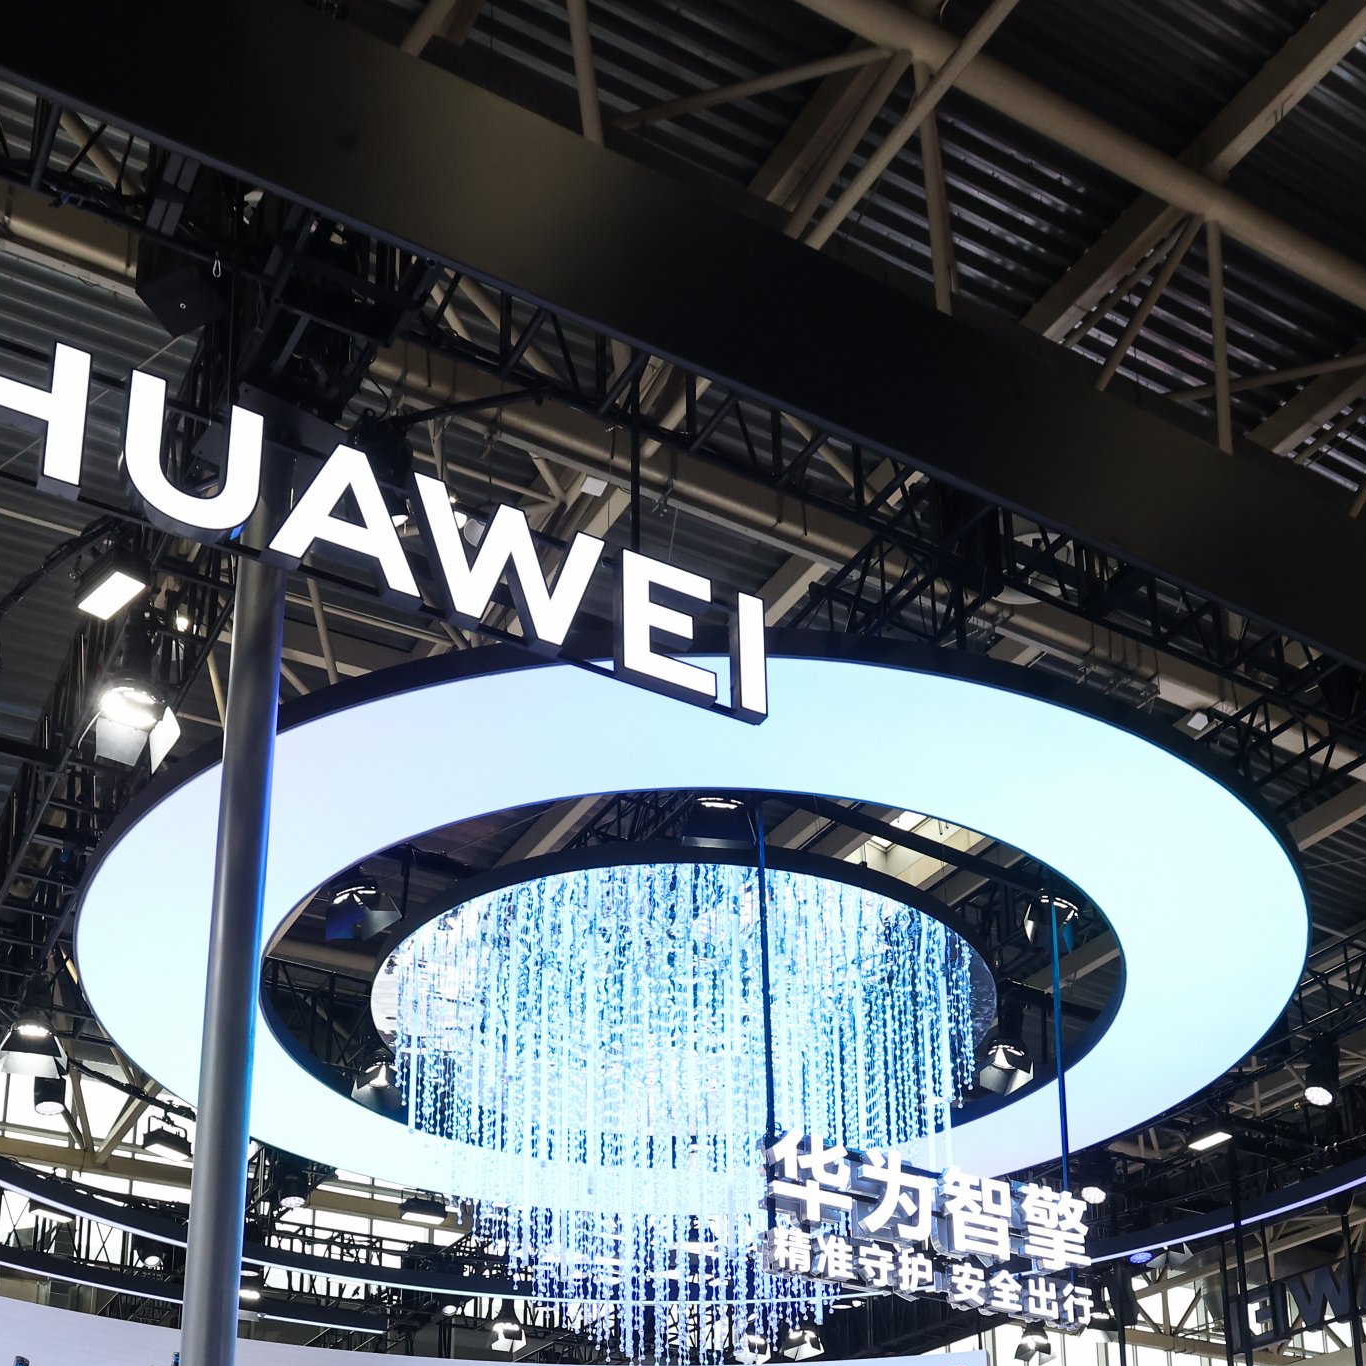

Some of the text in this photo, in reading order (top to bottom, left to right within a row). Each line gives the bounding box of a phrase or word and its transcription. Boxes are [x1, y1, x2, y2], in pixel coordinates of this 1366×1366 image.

[767, 1127, 1092, 1273] 华为智擎
[773, 1226, 1095, 1325] 精准守护 安全出行
